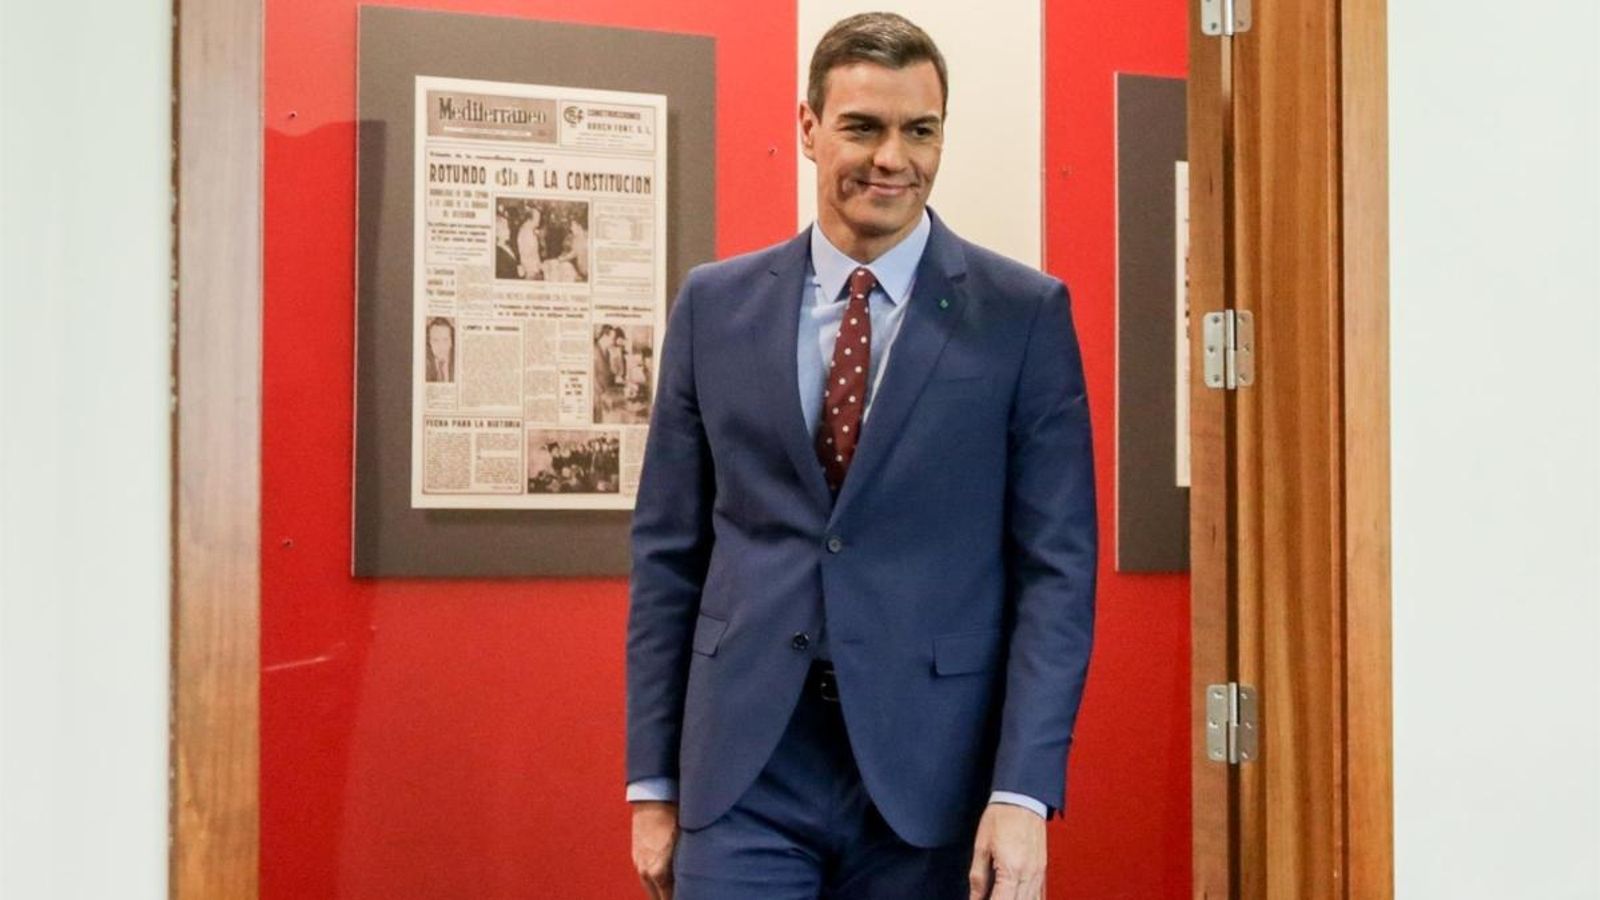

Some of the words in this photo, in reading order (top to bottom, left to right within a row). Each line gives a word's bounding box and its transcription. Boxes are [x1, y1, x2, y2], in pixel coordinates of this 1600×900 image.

[429, 162, 486, 186] ROTUNDO
[527, 168, 535, 188] A
[544, 169, 558, 189] LA
[567, 171, 652, 195] CONSTITUCION
[451, 419, 472, 429] PARA
[474, 420, 484, 429] LA
[487, 420, 521, 429] HISTORIA
